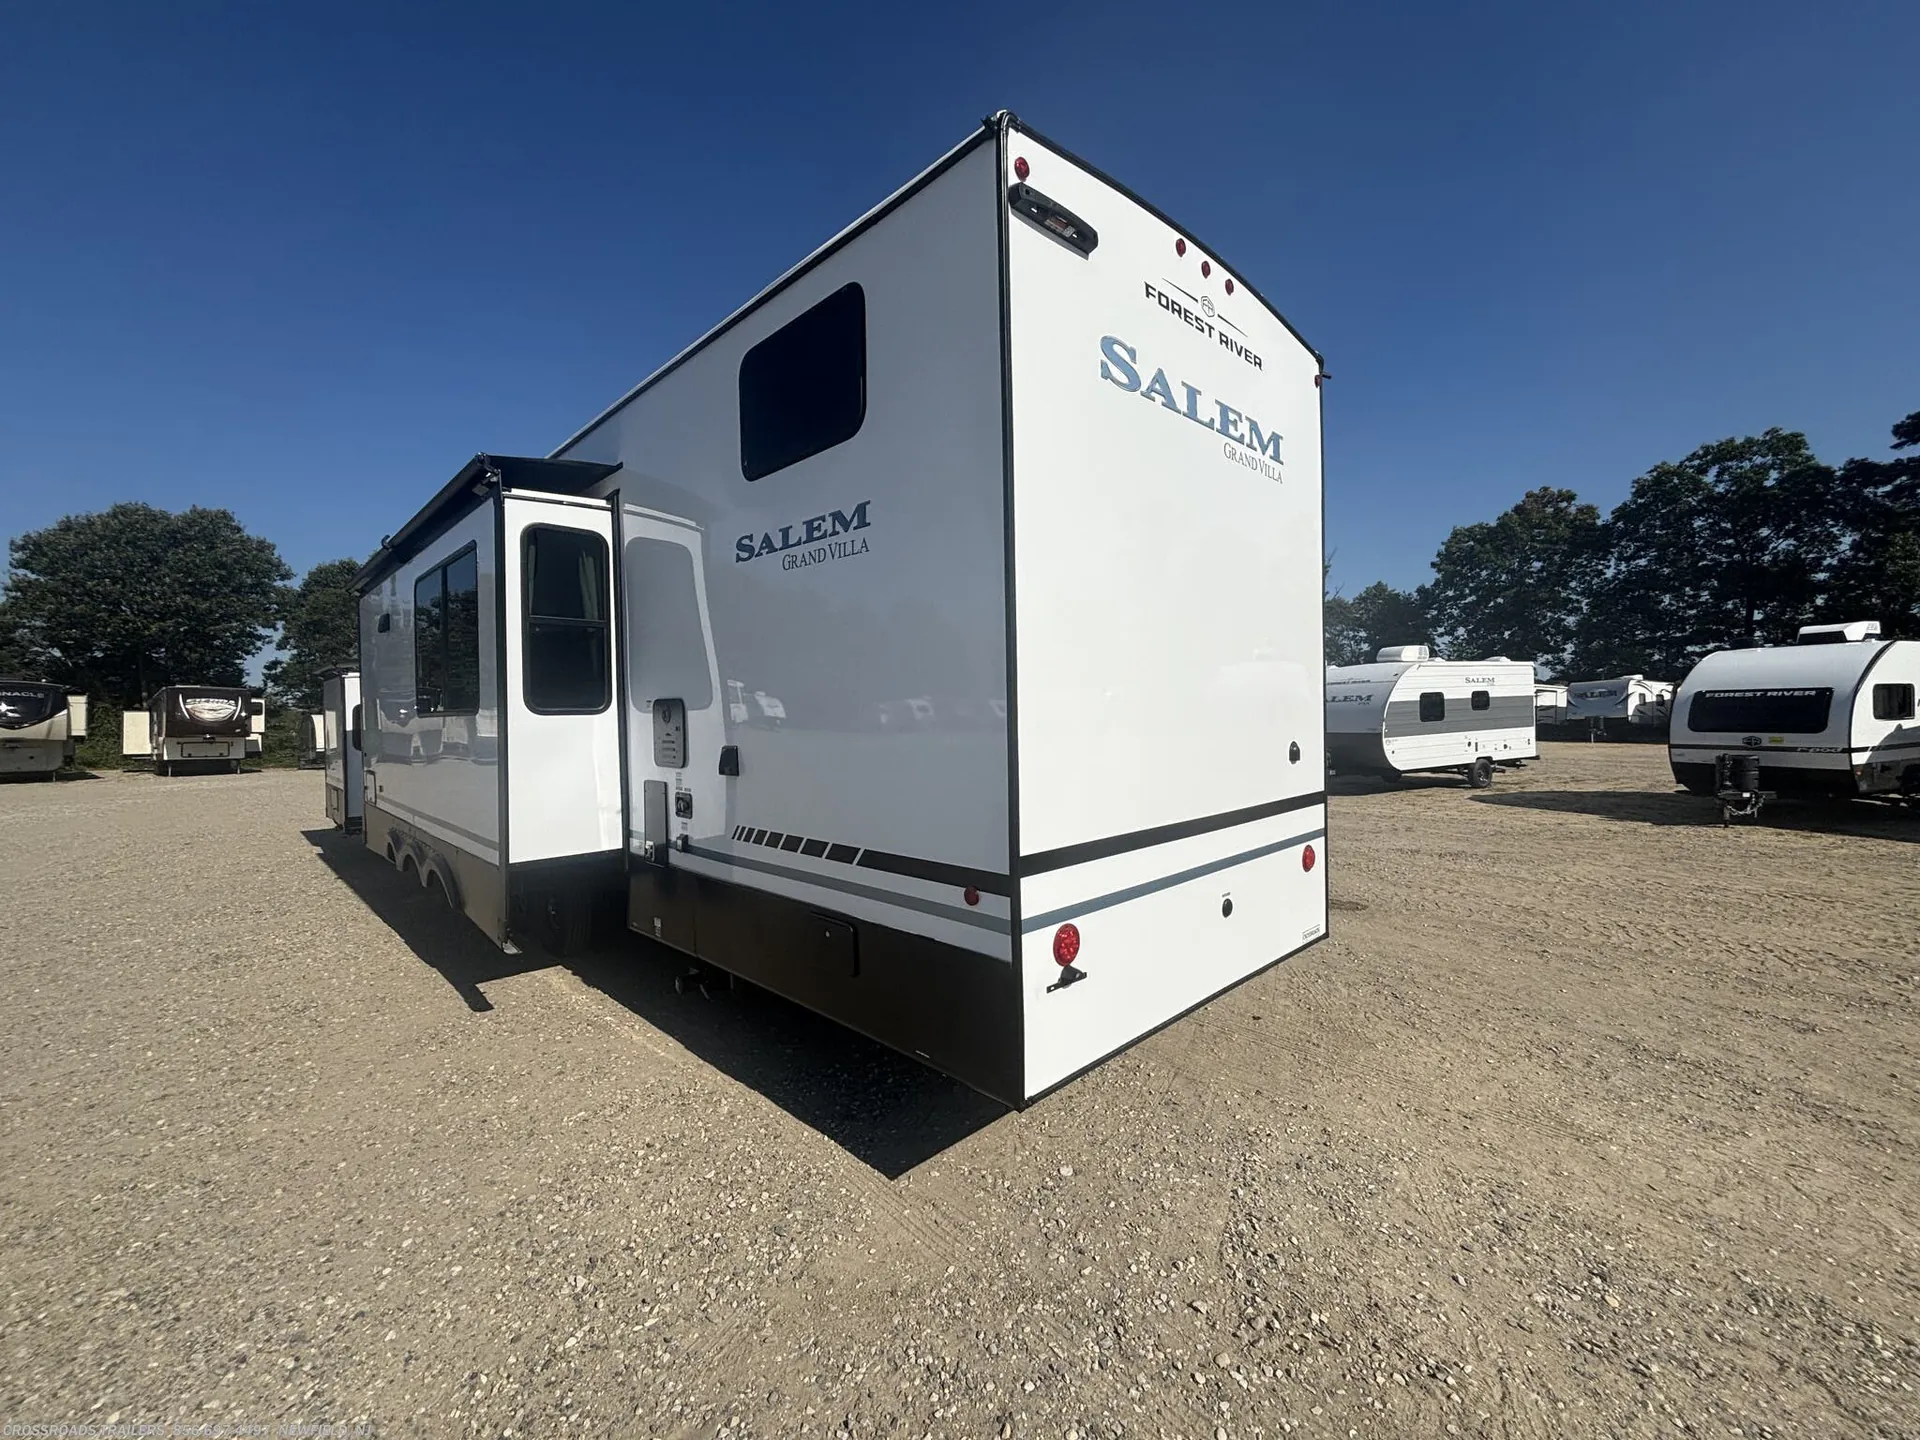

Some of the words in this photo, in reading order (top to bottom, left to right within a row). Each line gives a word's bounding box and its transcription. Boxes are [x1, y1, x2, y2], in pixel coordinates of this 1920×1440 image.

[1144, 281, 1215, 339] FOREST
[1219, 330, 1263, 371] RIVER
[1100, 335, 1284, 465] SALEM
[1224, 442, 1258, 472] GRAND
[1258, 457, 1283, 484] VILLA
[735, 500, 871, 563] SALEM
[781, 543, 827, 572] GRAND
[828, 537, 870, 561] VILLA
